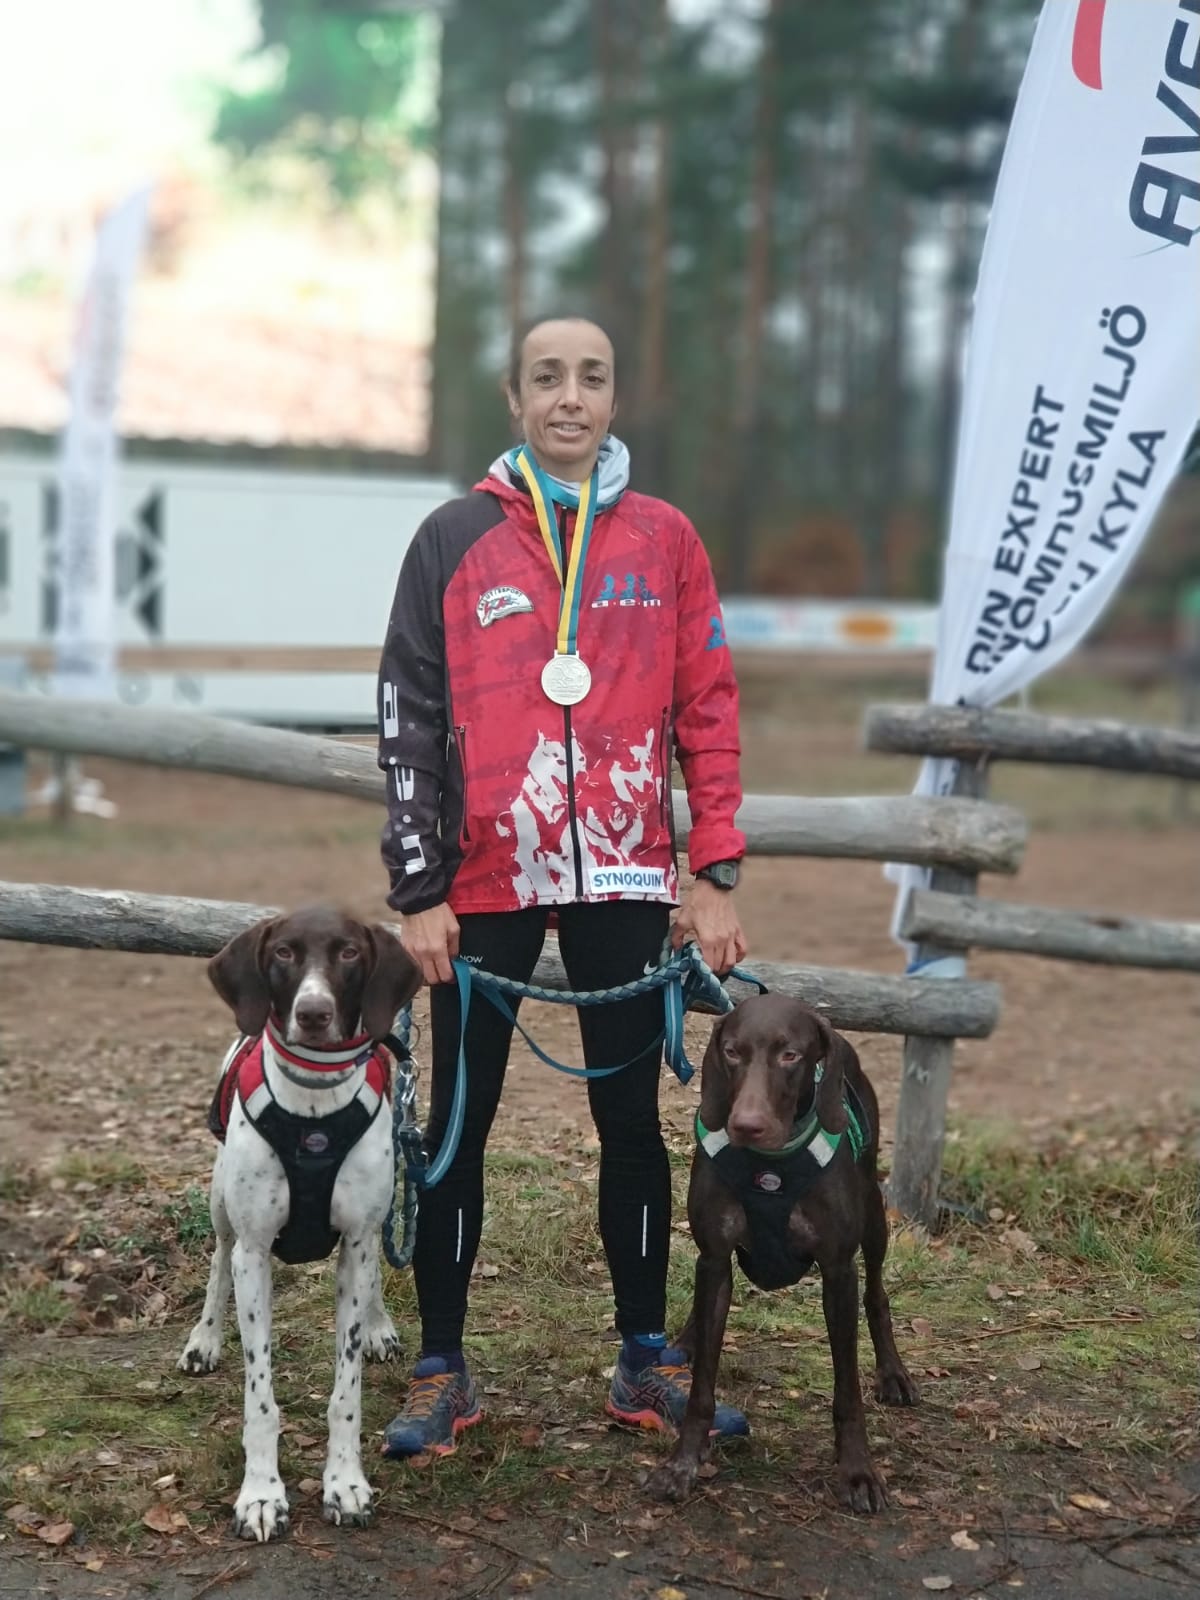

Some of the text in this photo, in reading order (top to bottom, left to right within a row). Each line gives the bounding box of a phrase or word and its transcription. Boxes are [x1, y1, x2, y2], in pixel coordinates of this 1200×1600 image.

[1129, 0, 1200, 246] AVE
[965, 589, 1012, 674] DIN
[994, 384, 1065, 576] EXPERT
[1090, 429, 1167, 552] KYLA
[593, 871, 662, 888] SYNOQUIN
